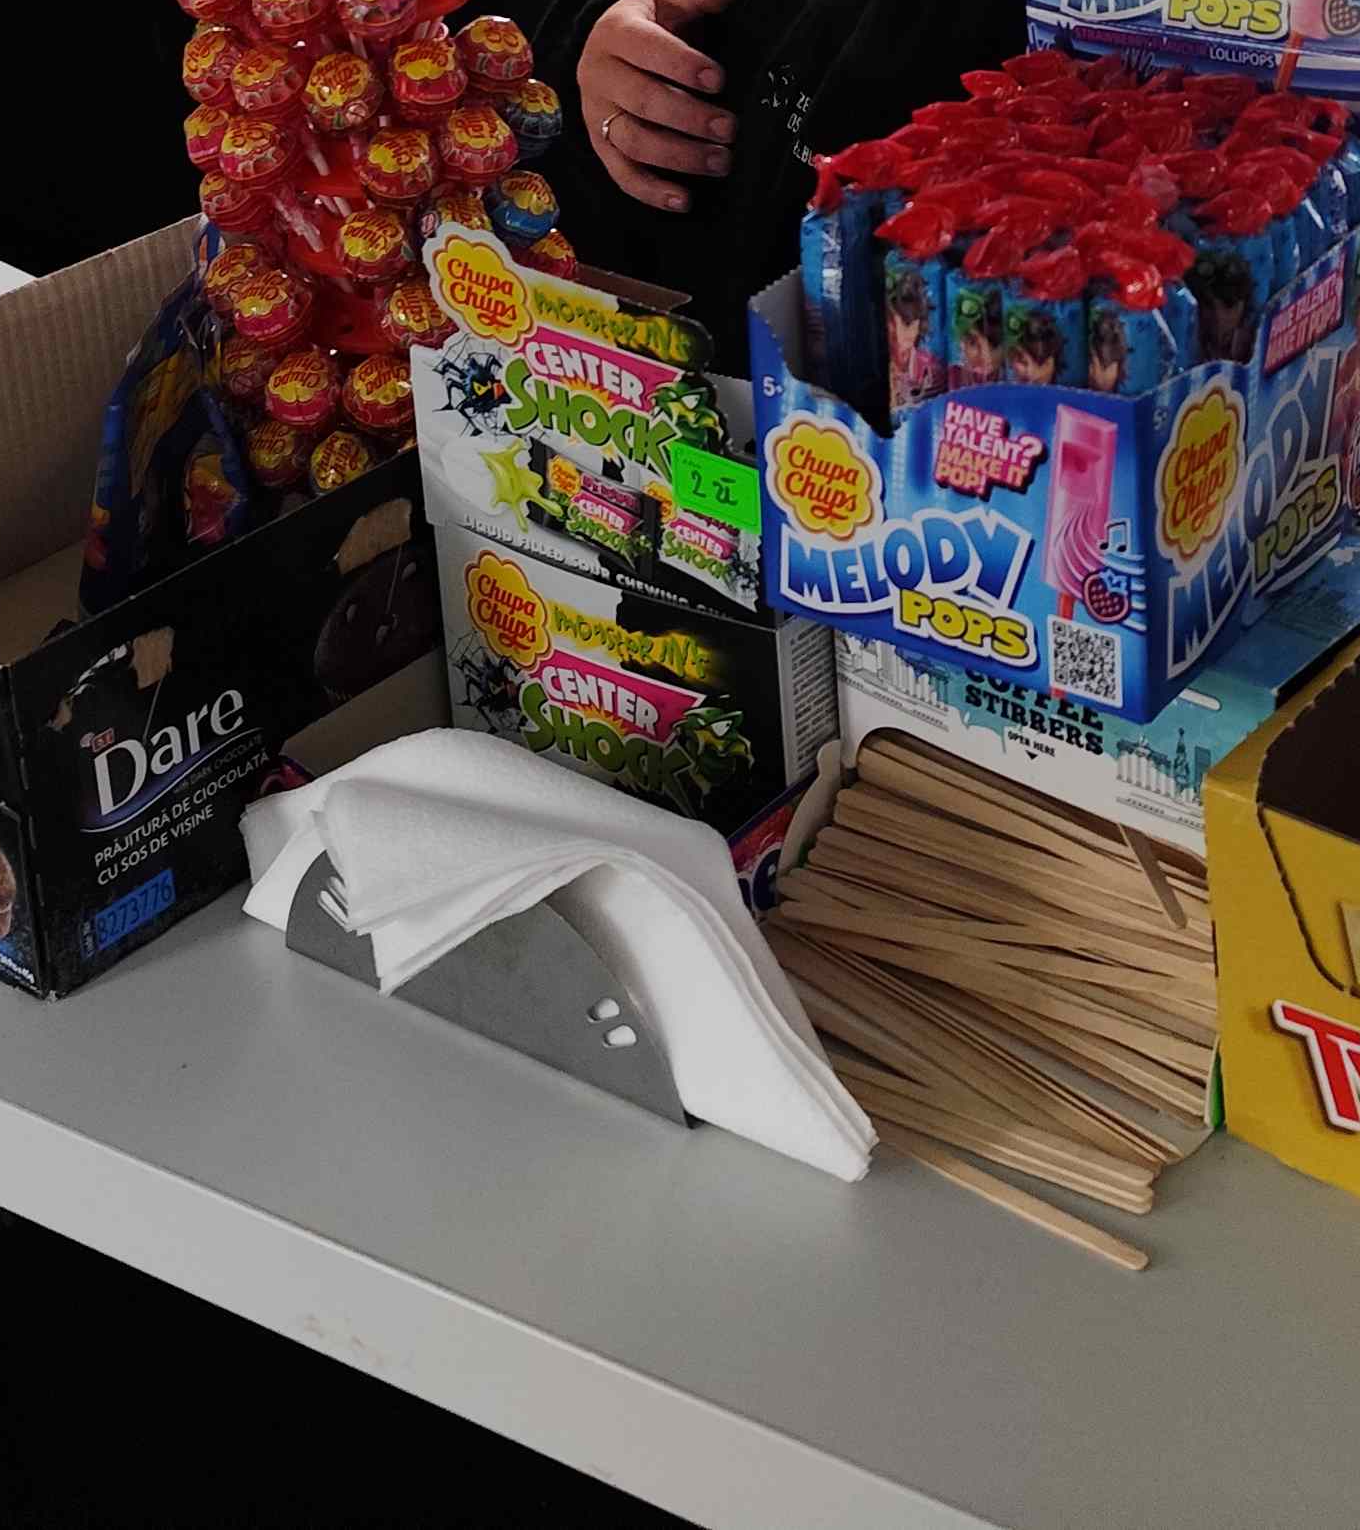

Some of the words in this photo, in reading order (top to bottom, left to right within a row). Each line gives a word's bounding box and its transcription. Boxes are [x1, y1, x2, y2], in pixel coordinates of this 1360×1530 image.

[1209, 46, 1276, 69] LOLLIPOPS
[446, 259, 514, 302] Chupa
[449, 280, 517, 327] Chups
[526, 341, 645, 408] CENTER
[762, 376, 784, 397] 5+
[504, 357, 680, 482] SHOCK
[945, 401, 1003, 437] HAVE
[787, 444, 860, 485] Chupa
[938, 443, 1003, 480] MAKE
[1007, 464, 1029, 487] IT
[944, 423, 1044, 468] TALENT?
[1172, 422, 1232, 489] Chupa
[784, 470, 858, 521] Chups
[935, 463, 987, 495] POP!
[1171, 459, 1228, 536] Chups
[581, 501, 626, 530] CENTER
[677, 526, 724, 556] CENTER
[1255, 464, 1338, 579] POPS
[465, 516, 513, 543] LIQUID
[518, 537, 565, 564] FILLED
[566, 555, 612, 581] SOUR
[787, 517, 1021, 604] MELODY
[477, 573, 537, 618] Chupa
[476, 597, 538, 652] Chups
[898, 588, 1031, 660] POPS
[542, 666, 659, 735] CENTER
[965, 682, 1105, 757] STIRRERS
[93, 688, 245, 818] Dare
[521, 680, 696, 795] SHOCK
[1007, 729, 1031, 750] OPEN
[1032, 741, 1056, 759] HERE
[172, 798, 191, 819] DE
[97, 865, 120, 886] CU
[120, 844, 149, 873] SOS
[149, 835, 169, 855] DE
